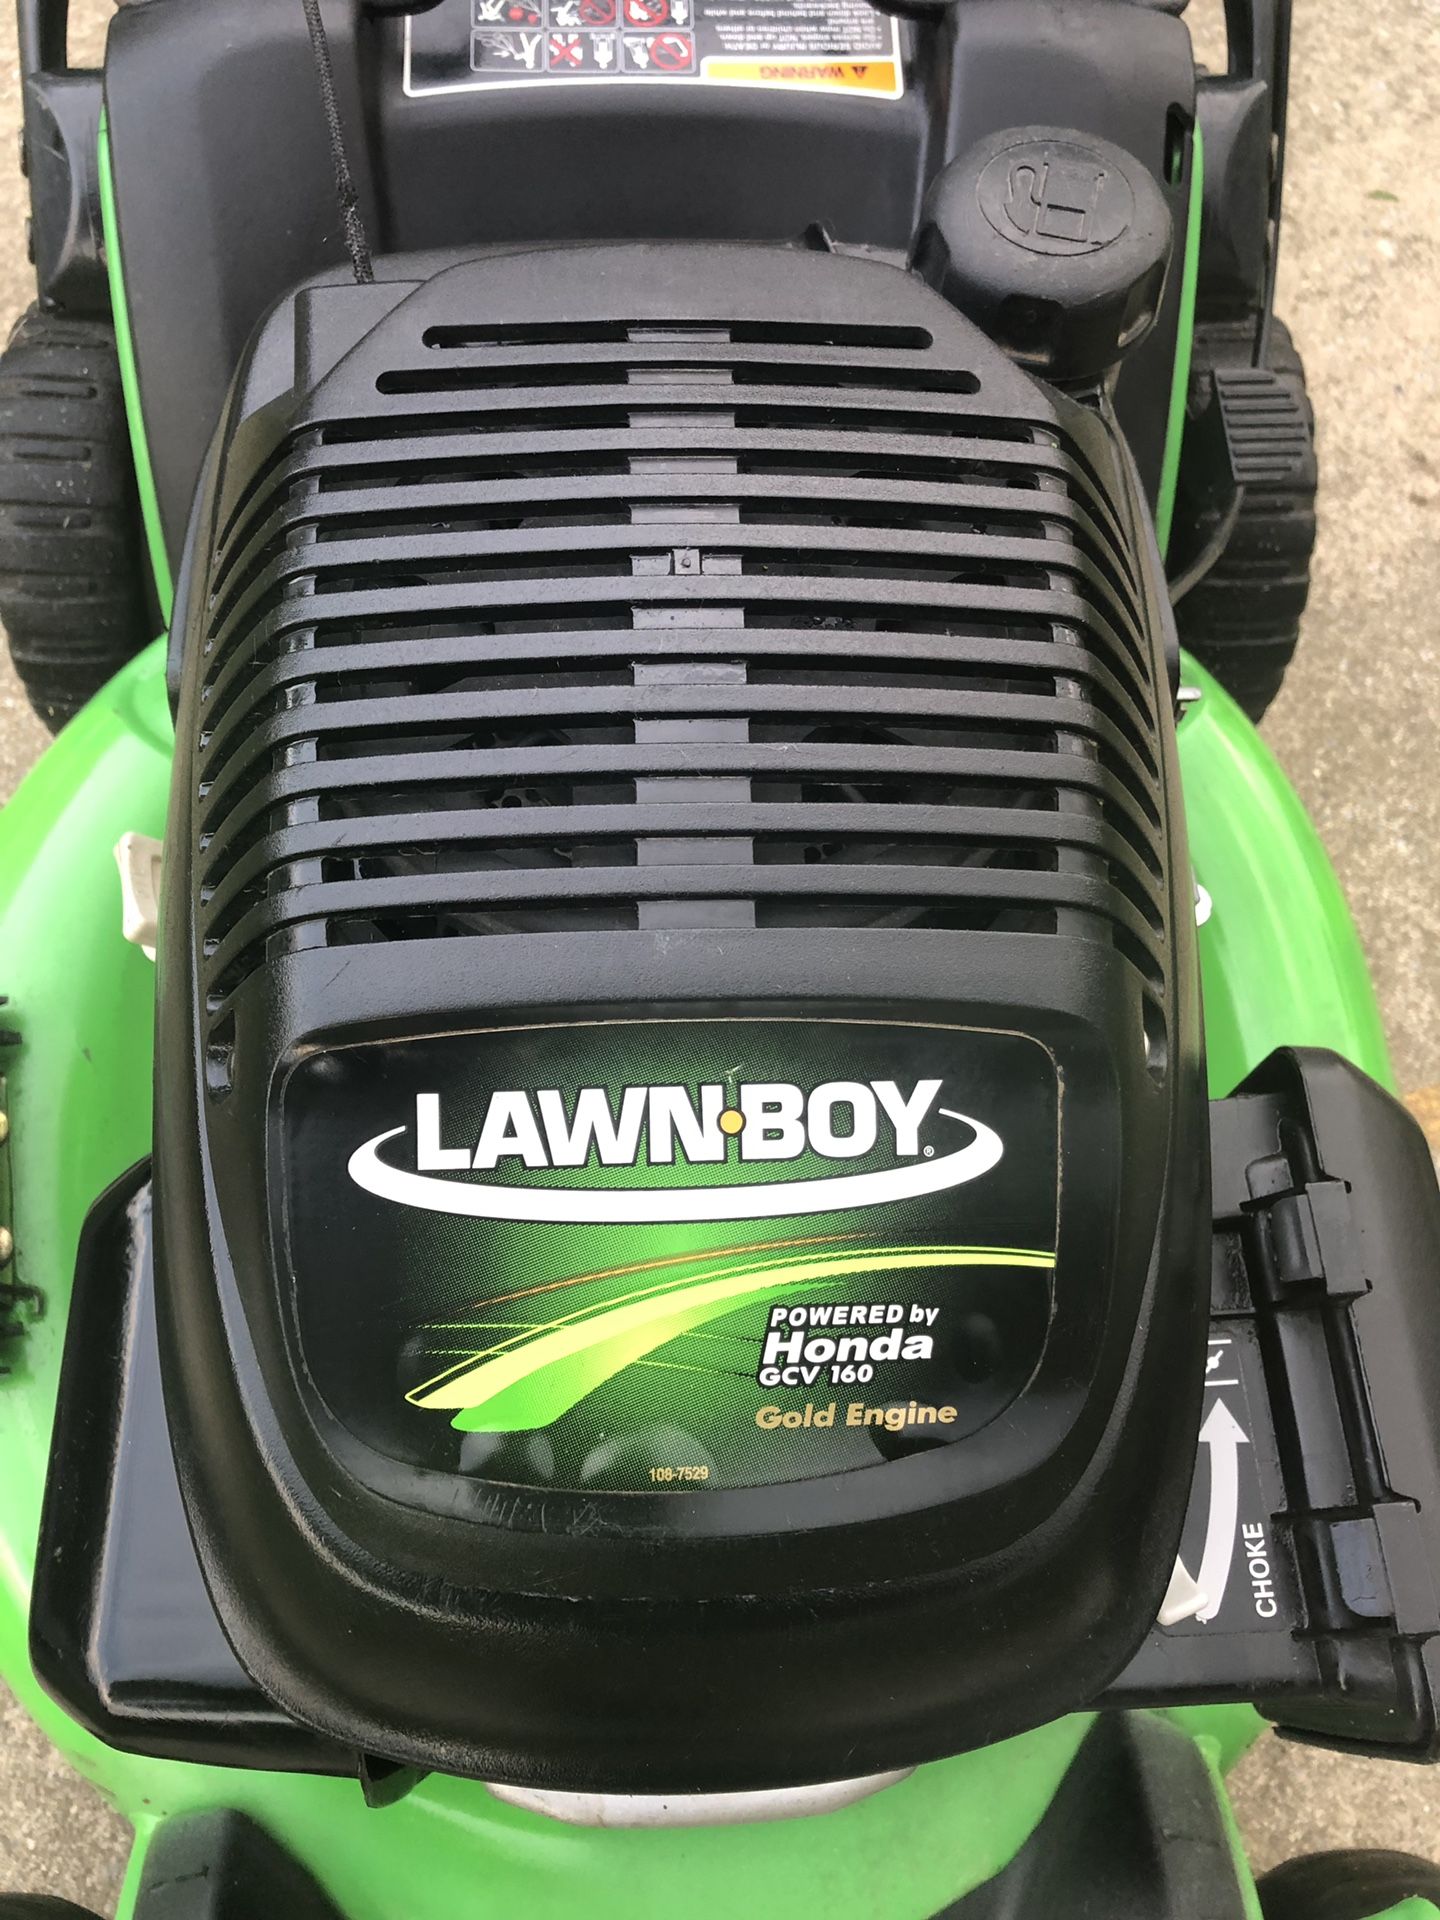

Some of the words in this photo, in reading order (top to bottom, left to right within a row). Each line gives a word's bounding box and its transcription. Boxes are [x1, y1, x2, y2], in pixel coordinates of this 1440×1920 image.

[760, 66, 844, 79] WARNING
[770, 1304, 904, 1328] POWERED
[909, 1304, 940, 1326] by
[762, 1328, 934, 1365] Honda
[759, 1366, 821, 1386] GCV
[831, 1364, 874, 1384] 160
[755, 1402, 836, 1430] Gold
[846, 1401, 958, 1432] Engine
[649, 1465, 709, 1482] 108-7529
[1242, 1522, 1278, 1618] CHOKE
